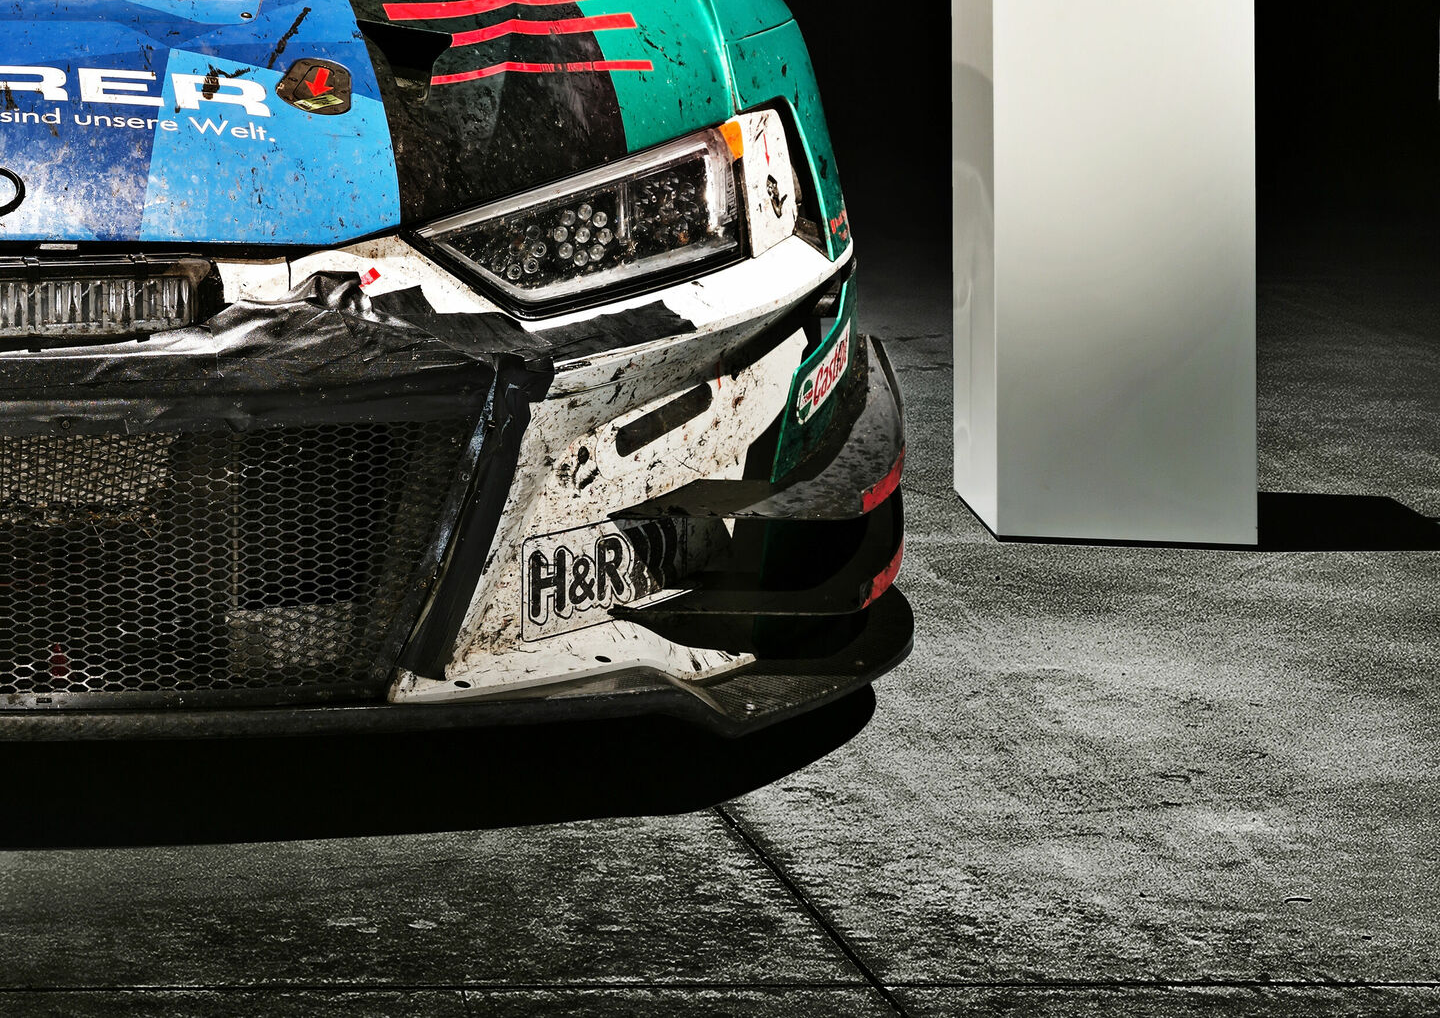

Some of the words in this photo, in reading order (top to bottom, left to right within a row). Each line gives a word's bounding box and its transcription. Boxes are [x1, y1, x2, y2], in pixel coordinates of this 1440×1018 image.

[0, 108, 62, 125] sind
[73, 114, 179, 132] unsere
[188, 116, 277, 143] Welt.
[529, 536, 626, 619] H&R
